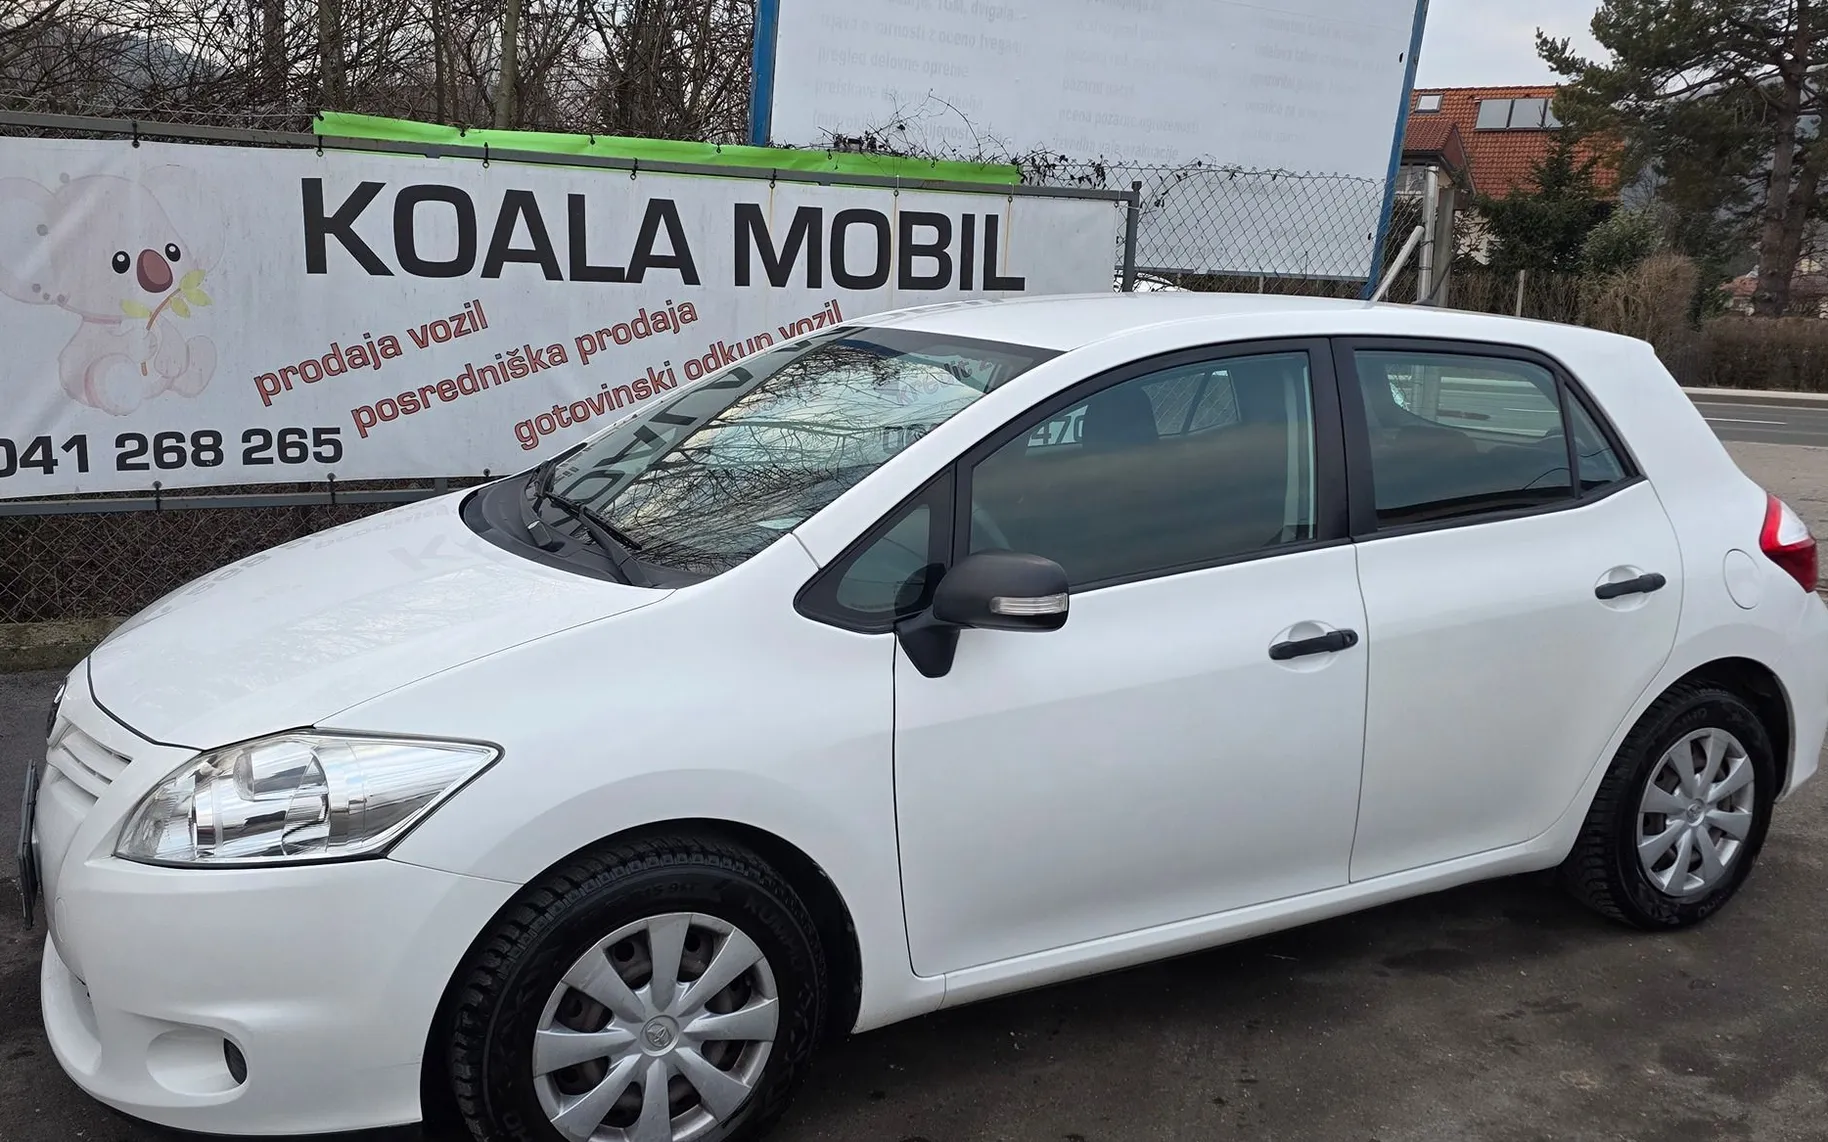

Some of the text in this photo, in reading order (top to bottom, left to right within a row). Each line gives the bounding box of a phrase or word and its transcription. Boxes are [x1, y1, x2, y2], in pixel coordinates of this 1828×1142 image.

[301, 178, 1025, 291] KOALA MOBIL
[253, 299, 489, 406] prodaja vozil
[350, 299, 699, 438] posredniška prodaja
[513, 360, 679, 451] gotovinski
[115, 430, 225, 471] 268
[241, 427, 343, 465] 265
